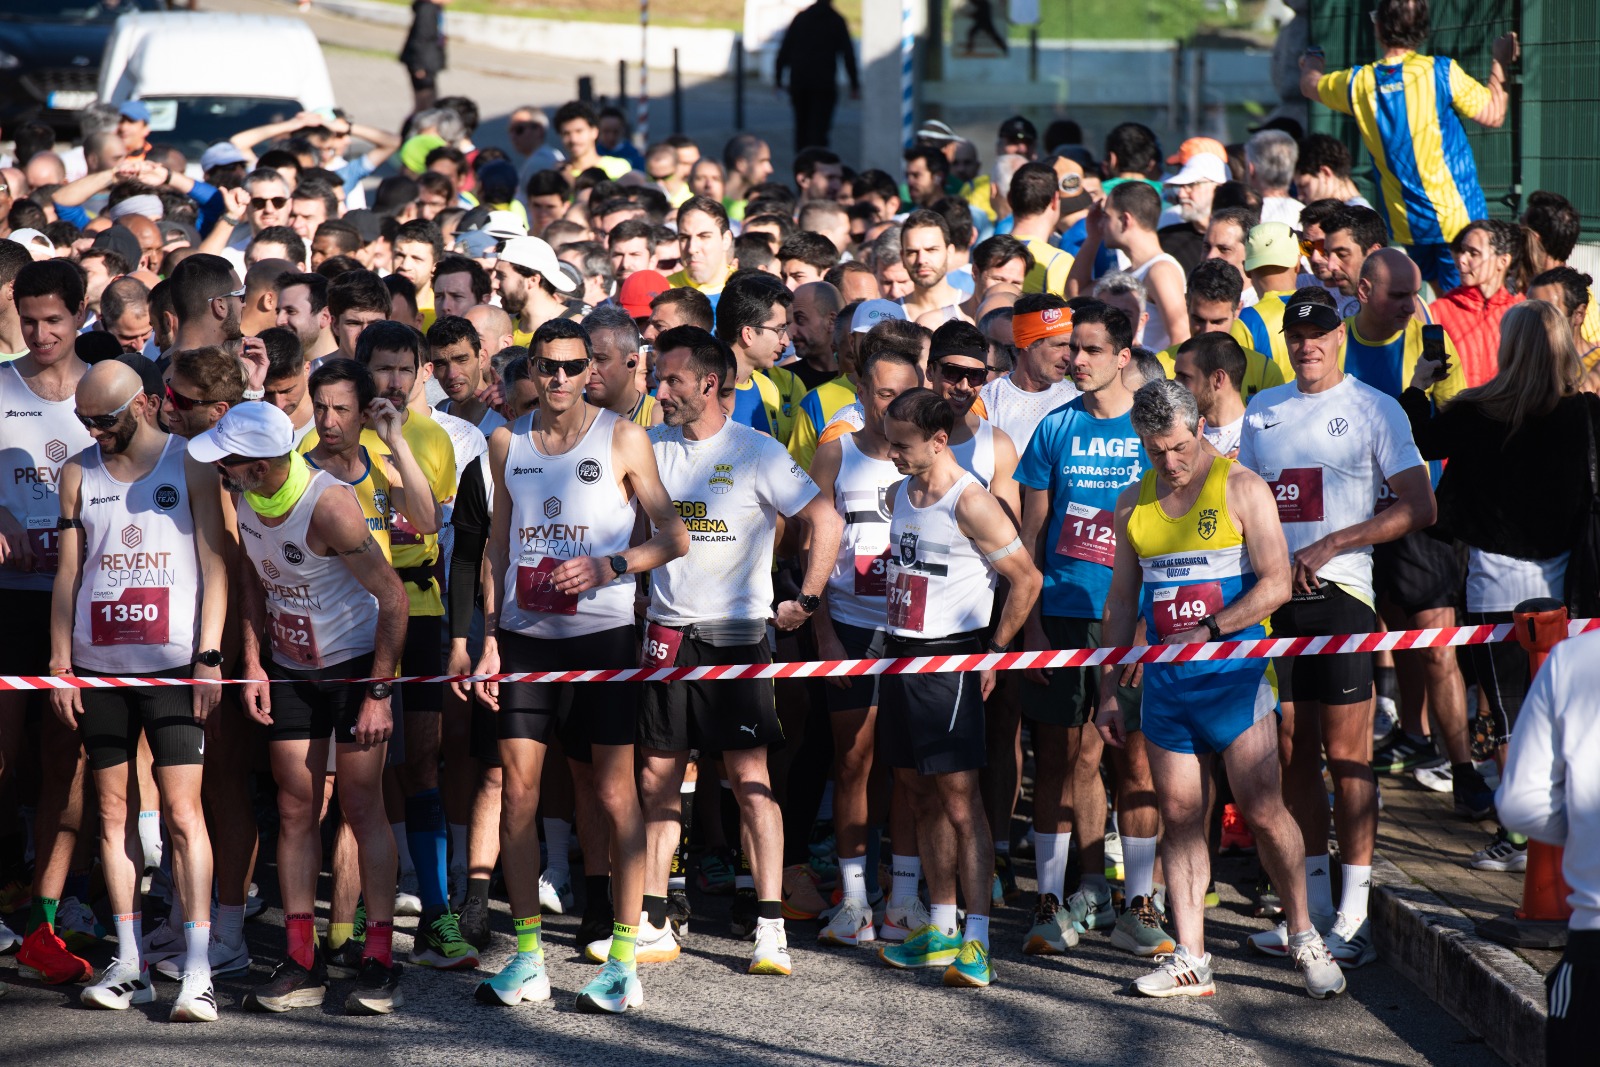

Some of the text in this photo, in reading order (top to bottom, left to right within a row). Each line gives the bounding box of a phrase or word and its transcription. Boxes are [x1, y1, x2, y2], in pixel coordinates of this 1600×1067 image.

[1071, 436, 1140, 458] LAGE
[1063, 465, 1125, 476] CARRASCO
[1076, 479, 1118, 489] AMIGOS
[1276, 484, 1300, 501] 29
[691, 534, 737, 542] BARCARENA
[1072, 520, 1116, 547] 112
[99, 551, 172, 571] REVENT
[107, 568, 175, 588] SPRAIN
[889, 586, 912, 607] 374
[101, 603, 159, 622] 1350
[1167, 600, 1207, 620] 149
[272, 620, 310, 647] 1722
